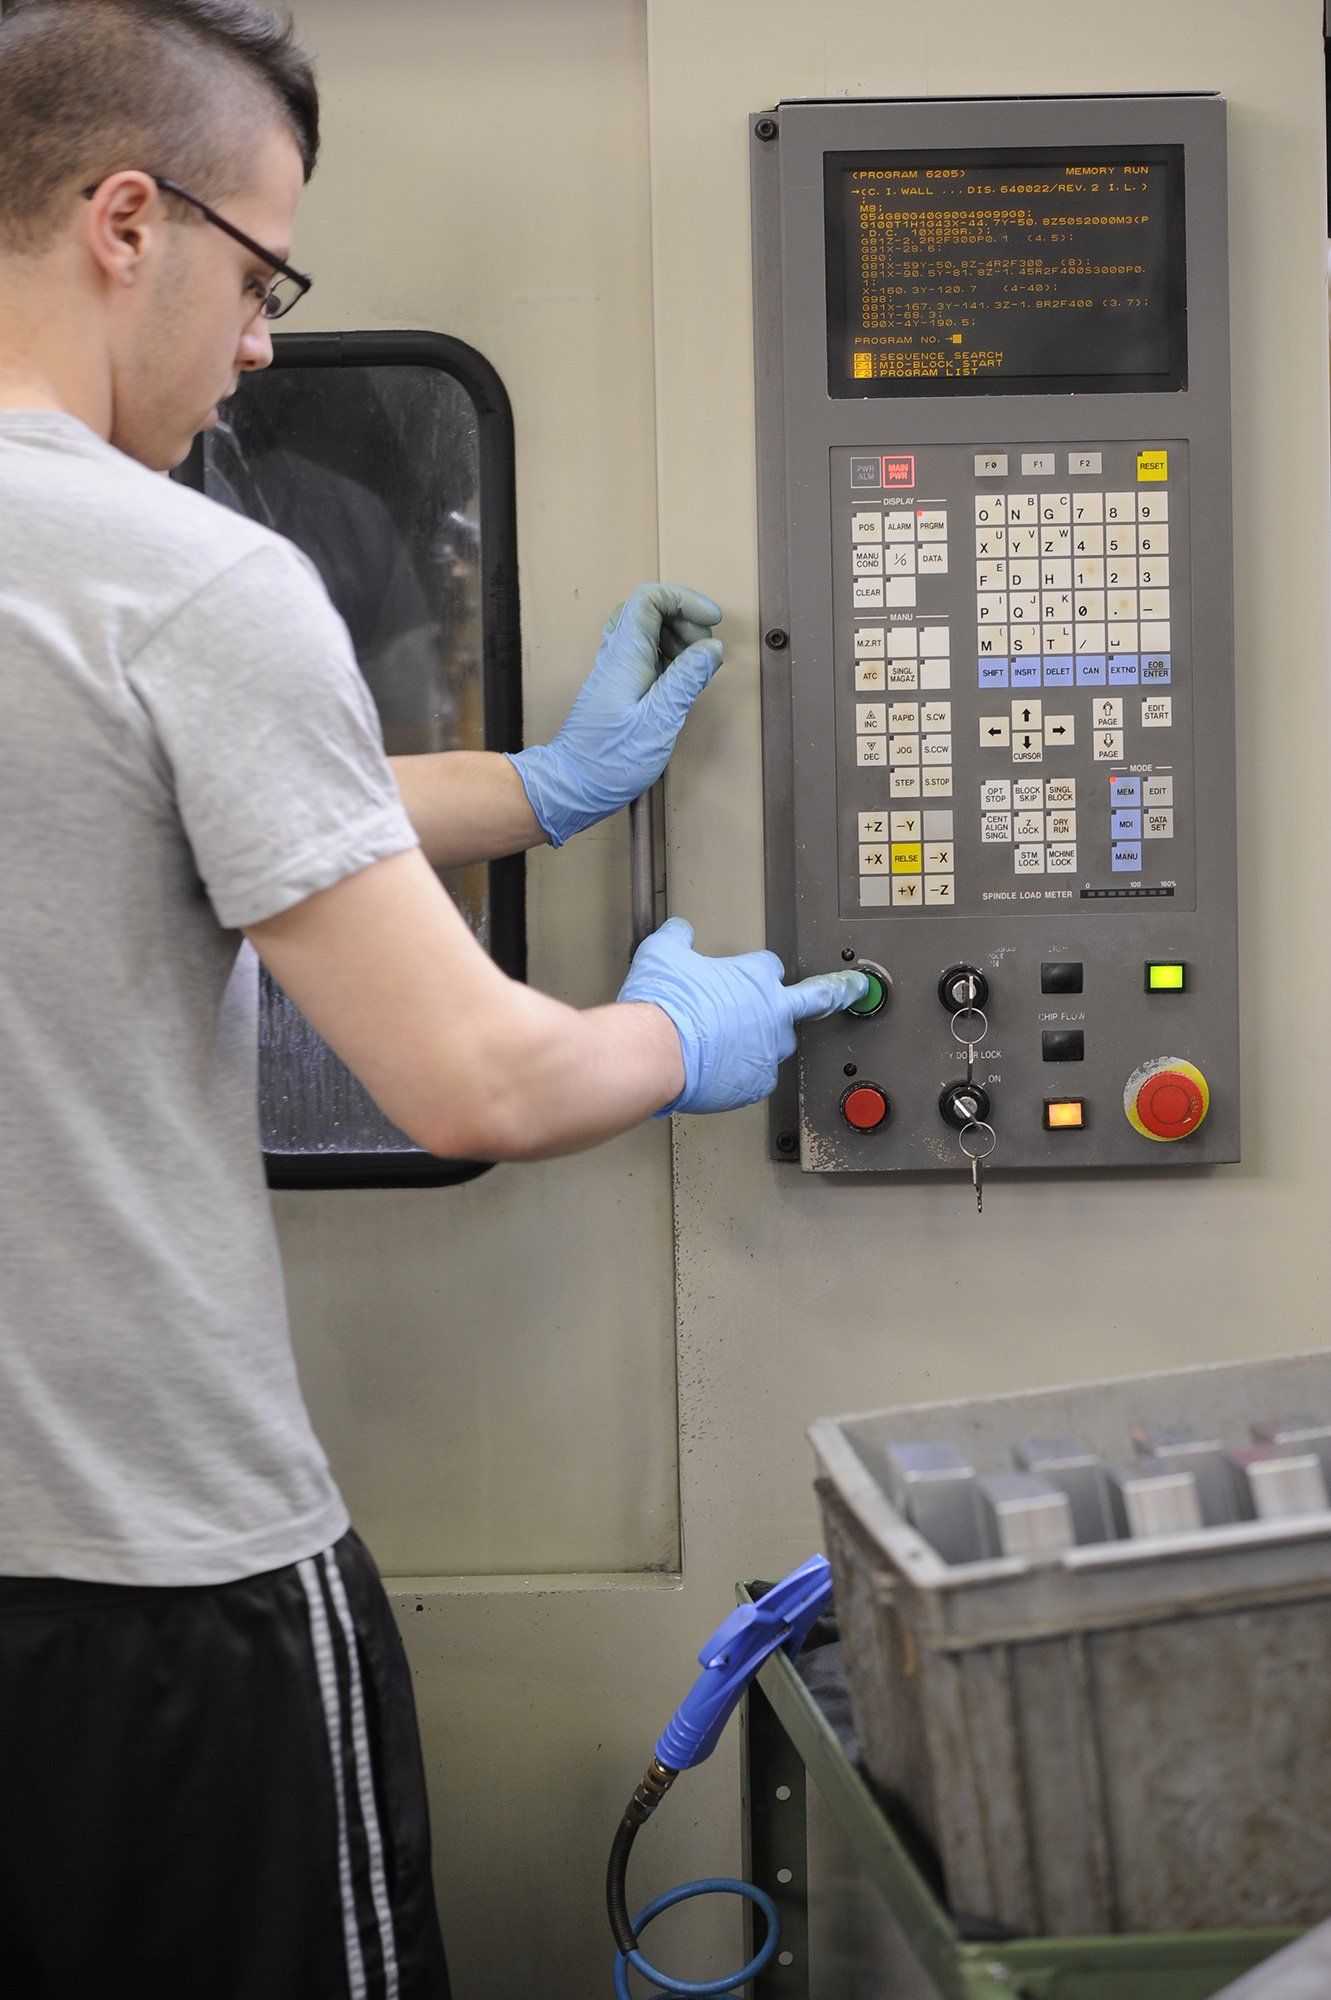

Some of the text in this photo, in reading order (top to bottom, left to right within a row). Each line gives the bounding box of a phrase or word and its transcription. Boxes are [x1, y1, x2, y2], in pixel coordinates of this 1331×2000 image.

[852, 169, 966, 181] (PROGRAM 6205)
[1065, 166, 1149, 176] MEMORY RUN
[854, 336, 913, 345] PROGRAM
[954, 351, 1003, 360] SEARCH
[962, 360, 1003, 368] START
[946, 368, 978, 377] LIST
[1033, 460, 1043, 468] F1
[1080, 459, 1090, 467] F2
[1140, 462, 1164, 470] RESET
[857, 465, 875, 473] PWR
[888, 464, 908, 472] MAIN
[889, 472, 908, 480] PWR
[883, 497, 915, 506] DISPLAY
[995, 498, 1002, 506] A
[1027, 498, 1034, 506] B
[1060, 497, 1067, 505] C
[978, 510, 989, 521] O
[1011, 509, 1020, 520] N
[1044, 509, 1054, 520] G
[1076, 508, 1084, 519] 7
[1109, 507, 1117, 518] 8
[1141, 507, 1150, 517] 9
[858, 524, 875, 532] POS
[887, 523, 912, 531] ALARM
[920, 522, 944, 530] PRGRM
[996, 531, 1002, 539] U
[1028, 530, 1035, 538] V
[1059, 530, 1069, 538] W
[980, 543, 989, 553] X
[1012, 542, 1021, 553] Y
[1045, 541, 1053, 552] Z
[1077, 541, 1085, 551] 4
[1110, 540, 1118, 551] 5
[1142, 540, 1150, 550] 6
[894, 553, 907, 566] I/O
[856, 560, 879, 568] COND
[997, 564, 1003, 572] E
[980, 575, 987, 586] F
[1012, 575, 1021, 586] D
[1045, 574, 1054, 585] H
[1078, 573, 1083, 584] 1
[1110, 573, 1118, 583] 2
[1143, 572, 1151, 583] 3
[856, 589, 881, 597] CLEAR
[1030, 595, 1036, 604] J
[1062, 595, 1069, 603] K
[980, 608, 989, 618] P
[1013, 607, 1024, 619] Q
[1046, 607, 1055, 617] R
[1078, 606, 1087, 616] 0
[890, 613, 913, 621] MANU
[1063, 627, 1069, 635] L
[981, 641, 992, 651] M
[1014, 640, 1023, 651] S
[1046, 639, 1055, 650] T
[1148, 661, 1164, 669] EOB
[982, 669, 1004, 677] SHIFT
[1014, 668, 1037, 676] INSRT
[1046, 668, 1070, 676] DELET
[1083, 667, 1100, 675] CAN
[1110, 666, 1136, 674] EXTND
[1143, 670, 1169, 678] ENTER
[862, 672, 878, 680] ATC
[1148, 704, 1165, 712] EDIT
[892, 714, 915, 722] RAPID
[926, 713, 946, 721] S.CW
[1144, 712, 1169, 720] START
[1098, 718, 1118, 726] PAGE
[896, 746, 913, 754] JOG
[1098, 750, 1118, 758] PAGE
[864, 753, 880, 761] DEC
[1013, 752, 1042, 760] CURSOR
[1129, 764, 1153, 772] MODE
[895, 779, 915, 787] STEP
[925, 778, 950, 786] S.STOP
[987, 787, 1003, 795] OPT
[1015, 786, 1041, 794] BLOCK
[1049, 786, 1072, 794] SINGL
[1116, 788, 1135, 796] MEM
[1149, 787, 1167, 795] EDIT
[985, 795, 1006, 803] STOP
[1019, 794, 1037, 802] SKIP
[1048, 794, 1074, 802] BLOCK
[986, 815, 1007, 823] CENT
[1026, 819, 1031, 827] Z
[1053, 818, 1068, 826] DRY
[1149, 816, 1167, 824] DATA
[864, 821, 883, 832] +Z
[896, 820, 915, 831] -Y
[985, 823, 1009, 831] ALIGN
[1119, 820, 1133, 828] MDI
[1018, 827, 1039, 835] LOCK
[1053, 826, 1069, 834] RUN
[929, 852, 948, 863] -X
[1021, 851, 1038, 859] STM
[1048, 850, 1075, 858] MCHINE
[1115, 853, 1138, 861] MANU
[864, 853, 883, 865] +X
[894, 855, 918, 863] RELSE
[1018, 858, 1040, 866] LOCK
[1051, 858, 1072, 866] LOCK
[898, 885, 916, 896] +Y
[930, 884, 949, 895] -Z
[982, 890, 1073, 900] SPINDLE LOAD METER
[1038, 1012, 1058, 1021] CHIP
[956, 1050, 979, 1060] DOR
[980, 1050, 1002, 1059] LOCK
[988, 1074, 1001, 1083] ON
